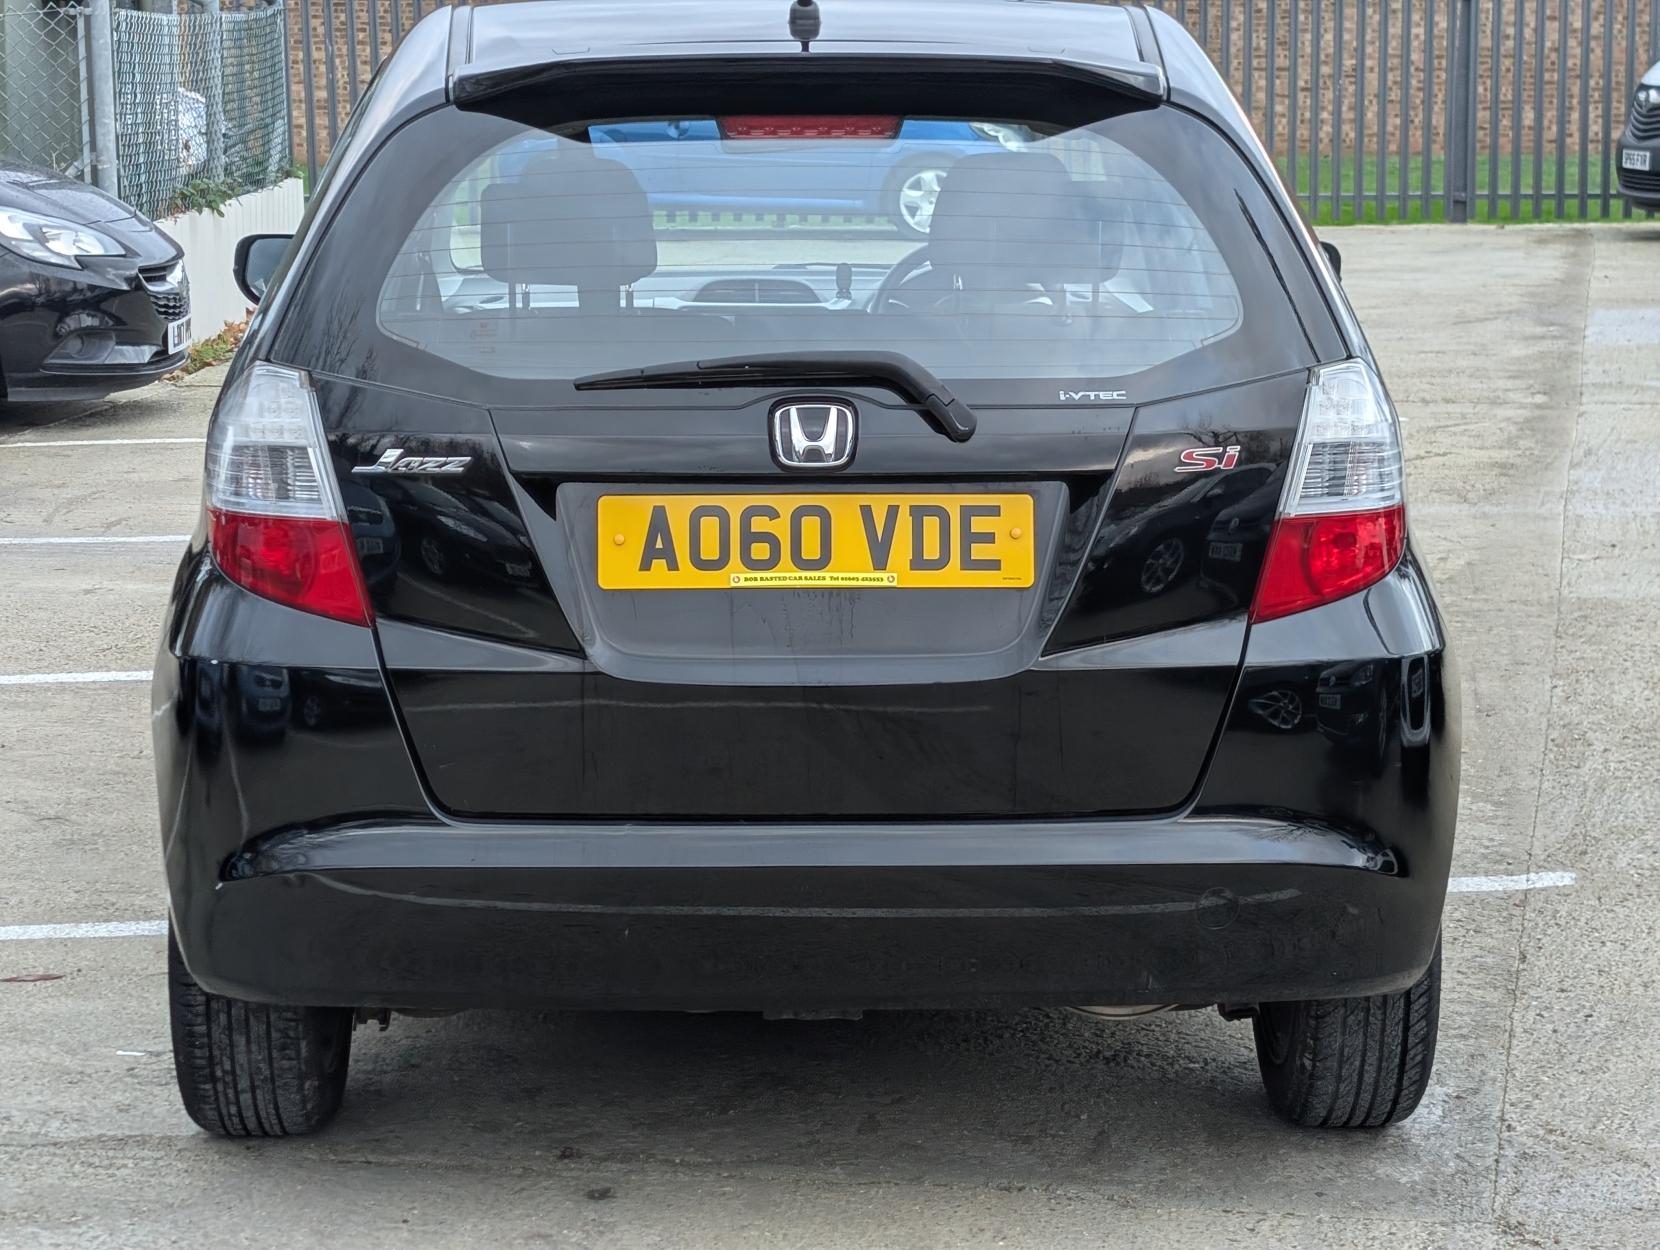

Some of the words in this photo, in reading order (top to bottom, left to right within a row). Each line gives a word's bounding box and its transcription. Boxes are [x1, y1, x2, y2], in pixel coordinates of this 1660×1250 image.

[351, 448, 472, 473] Jazz
[1174, 445, 1241, 473] Si
[638, 504, 832, 572] AO60
[859, 504, 1002, 571] VDE
